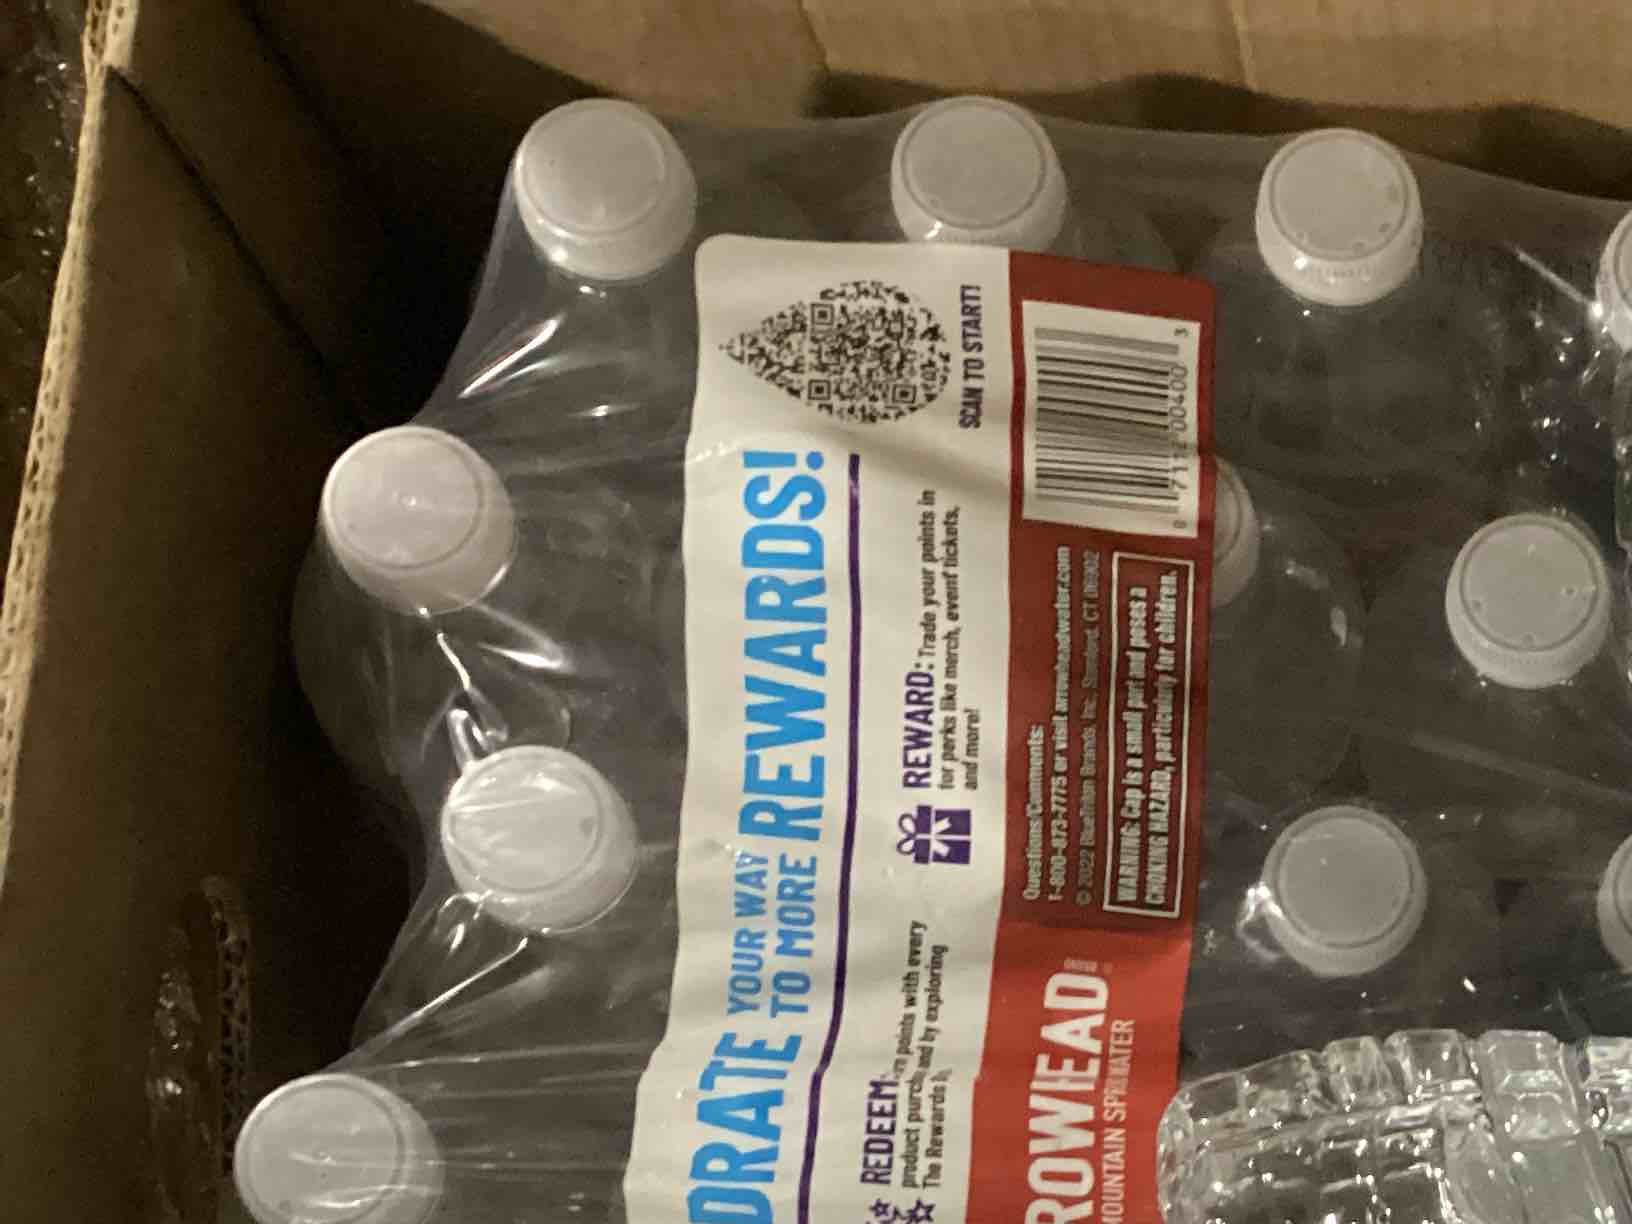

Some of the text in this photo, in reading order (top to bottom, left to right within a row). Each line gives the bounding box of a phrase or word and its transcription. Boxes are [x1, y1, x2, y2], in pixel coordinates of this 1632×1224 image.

[959, 285, 984, 429] SCAN TO START!
[736, 451, 827, 842] REWARDS!
[902, 489, 939, 790] REWARD: Trade your points in
[942, 627, 961, 679] merch,
[941, 684, 959, 712] like
[941, 716, 960, 762] perks
[963, 708, 980, 790] and more!
[939, 766, 957, 791] for
[727, 853, 770, 1016] YOUR WAY
[771, 853, 816, 1019] TO MORE
[907, 921, 926, 967] every
[901, 971, 920, 1008] with
[901, 1128, 920, 1188] product
[925, 944, 948, 1024] exploring
[925, 1085, 945, 1157] Rewards
[923, 1162, 940, 1188] The
